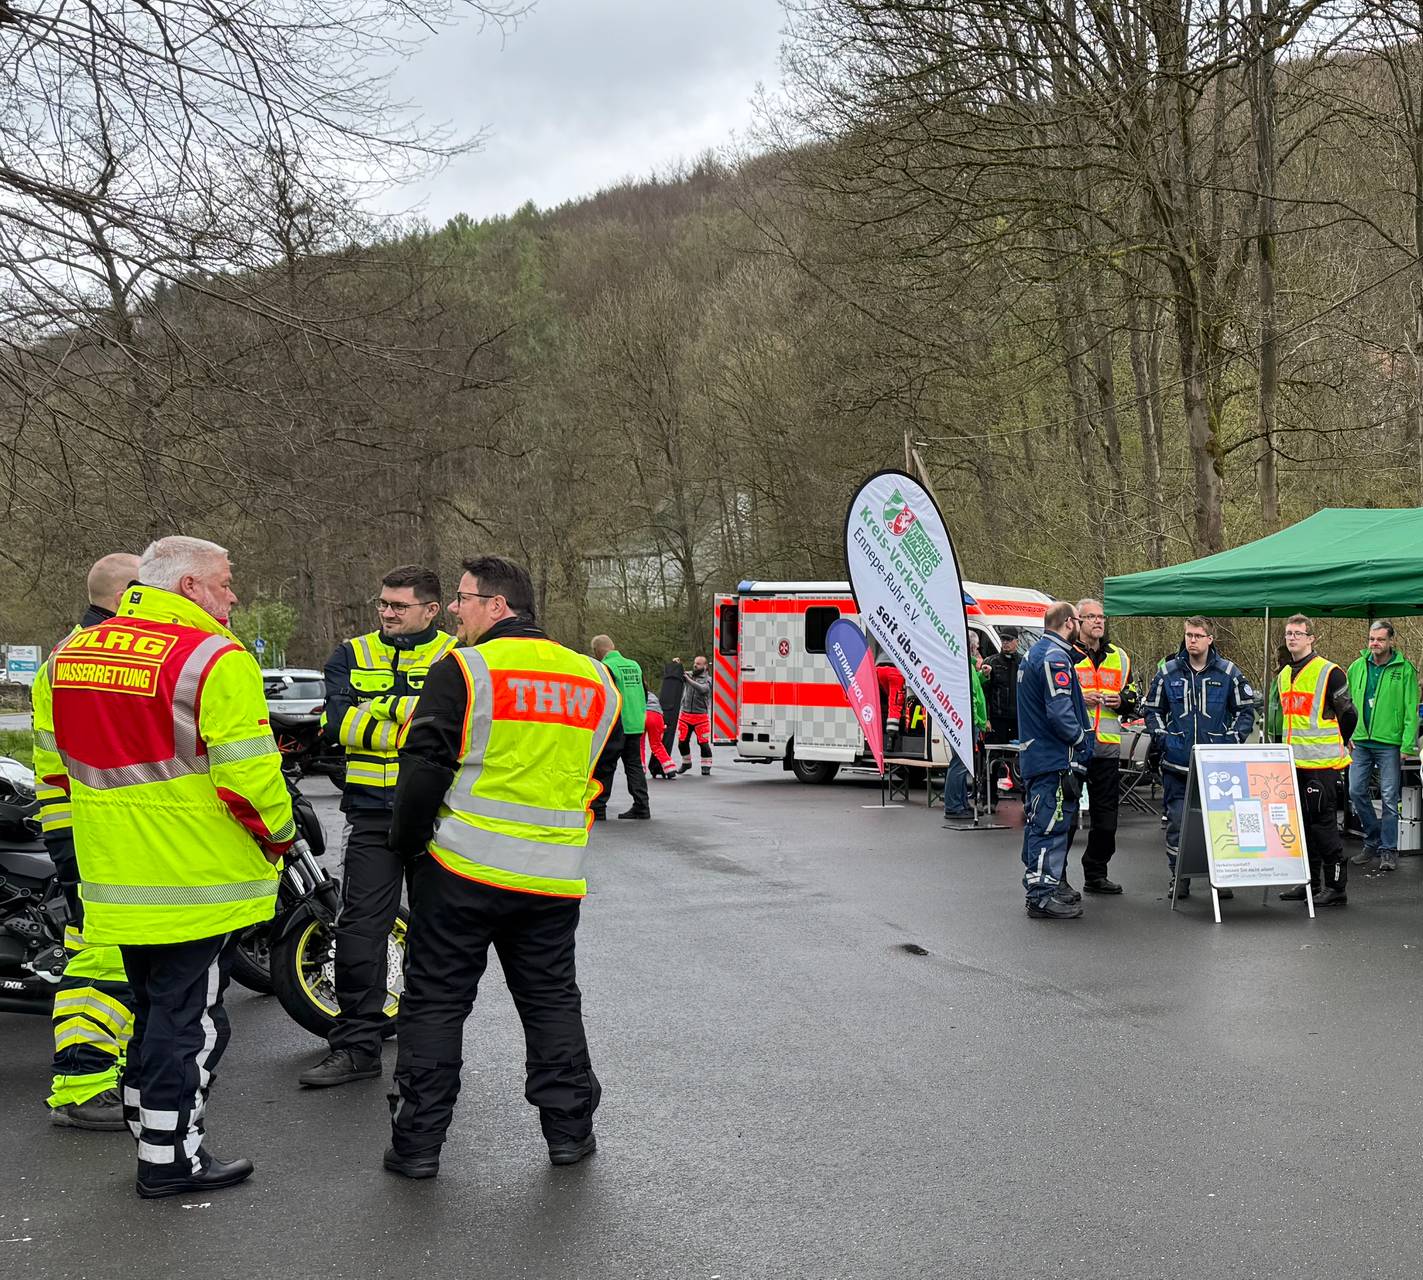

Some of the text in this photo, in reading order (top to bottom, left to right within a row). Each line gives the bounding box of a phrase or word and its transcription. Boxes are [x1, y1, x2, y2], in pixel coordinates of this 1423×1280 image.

[853, 527, 920, 625] Ennepe-Ruhr e.V.
[860, 505, 960, 657] Kreis-Verkehrswacht
[904, 532, 927, 563] WACHT
[56, 662, 151, 689] WASSERRETTUNG
[66, 630, 167, 655] DLRG
[876, 605, 964, 731] seit über 60 Jahren
[507, 677, 597, 719] THW
[868, 613, 914, 680] Verkehrserziehung
[920, 687, 963, 748] Ennepe-Ruhr-Kreis
